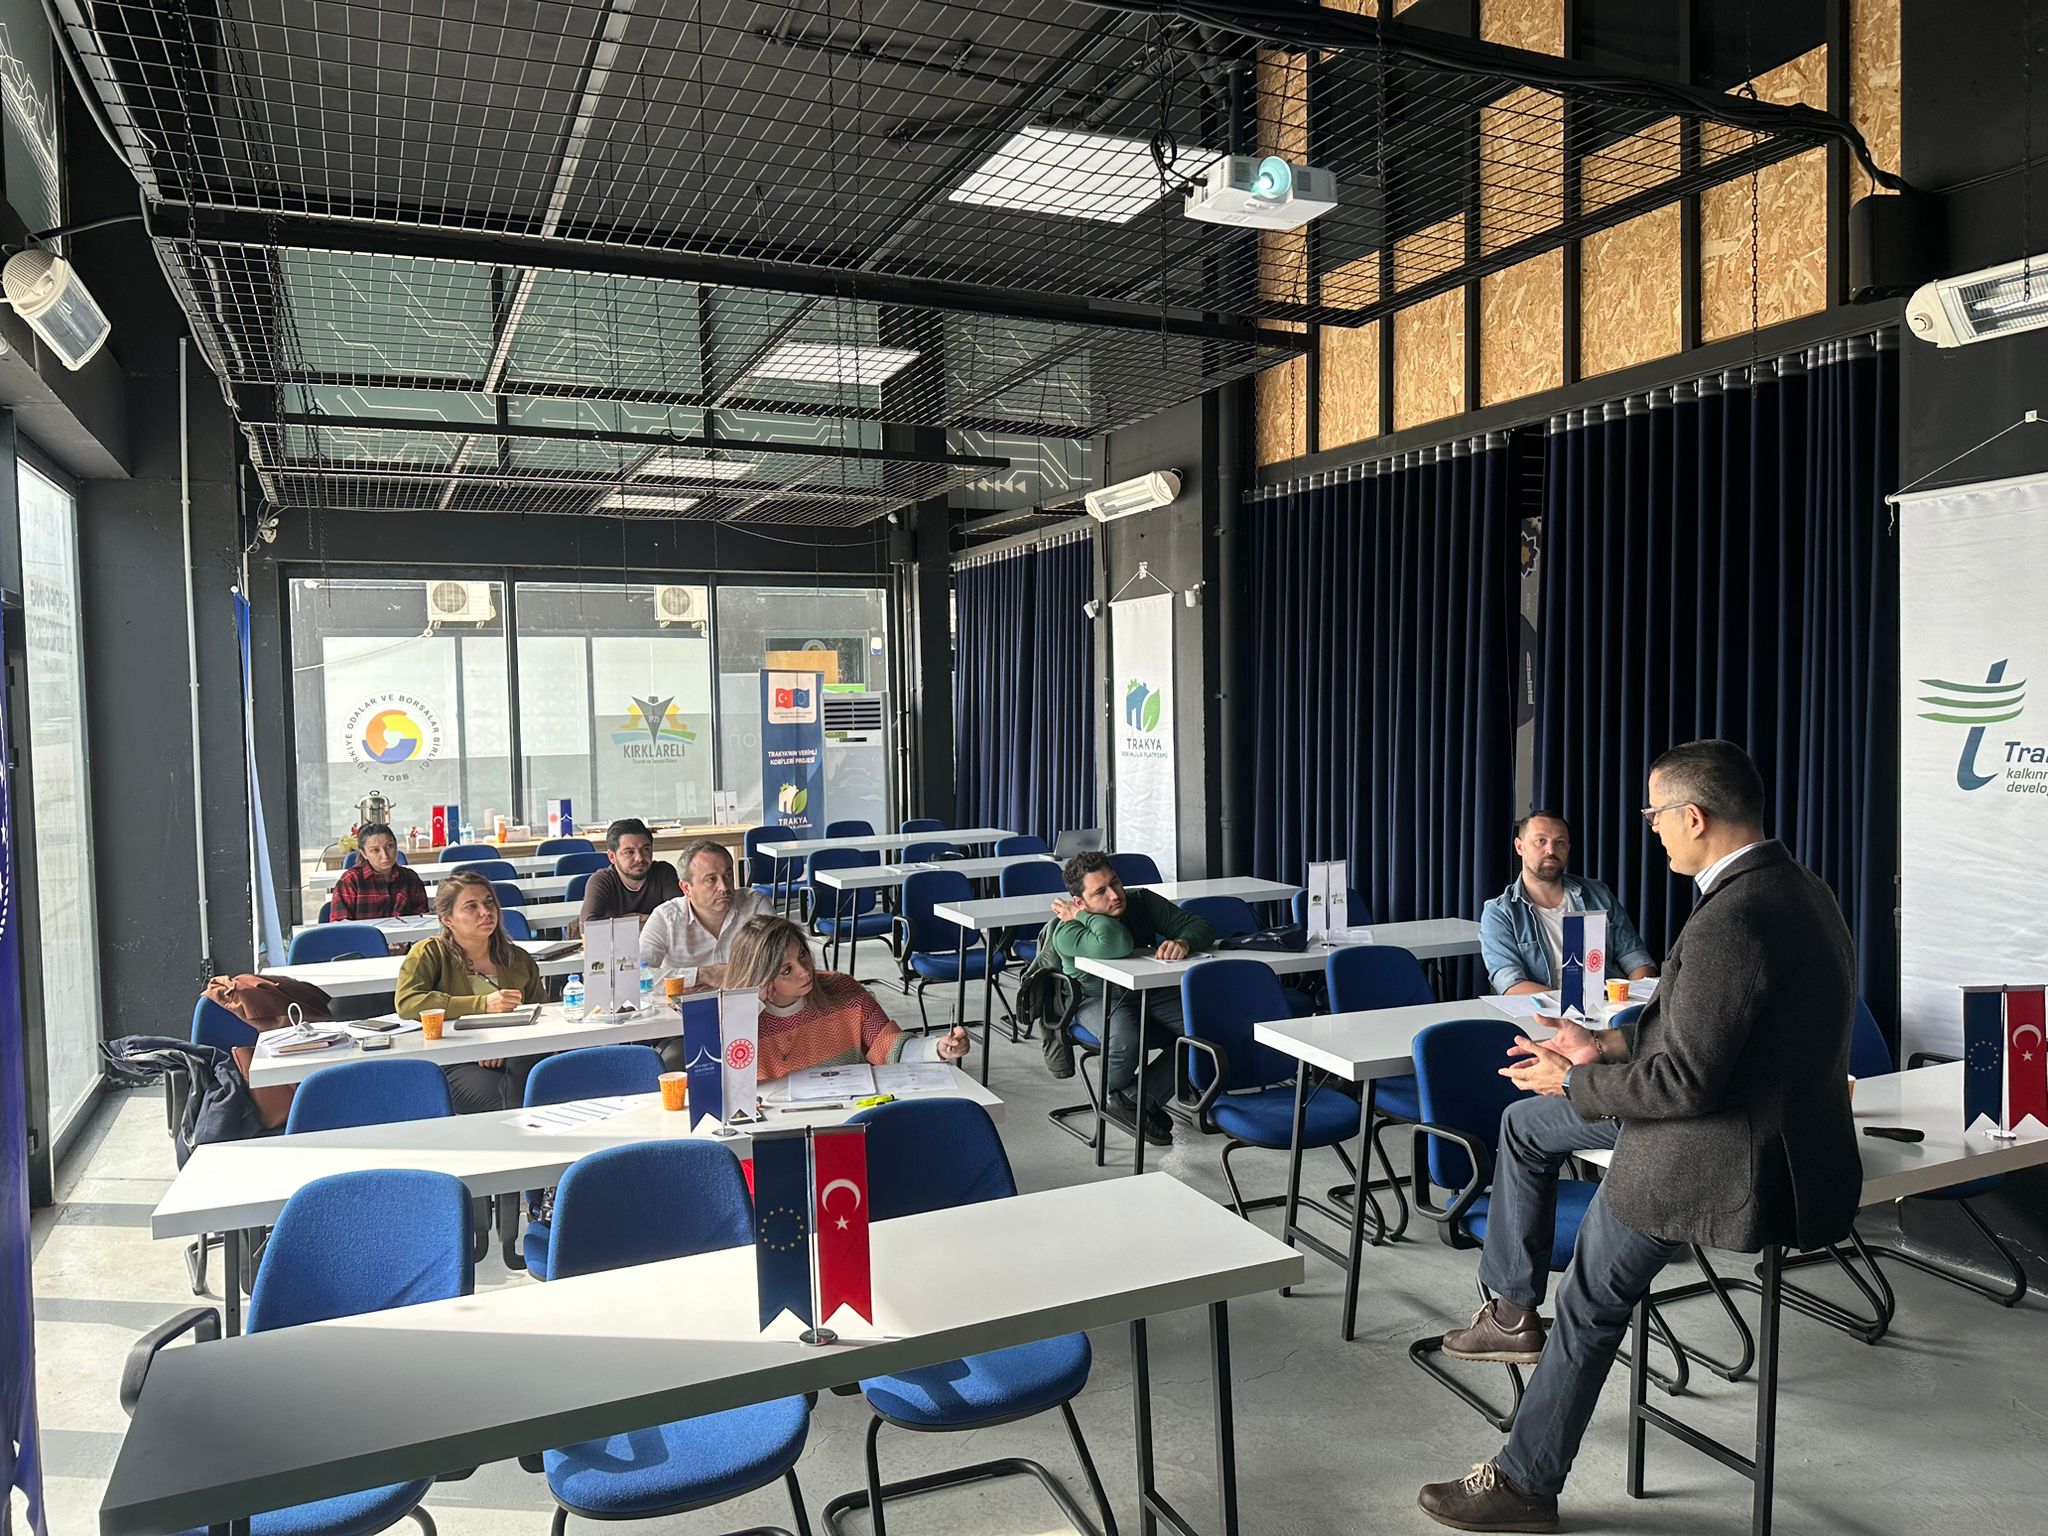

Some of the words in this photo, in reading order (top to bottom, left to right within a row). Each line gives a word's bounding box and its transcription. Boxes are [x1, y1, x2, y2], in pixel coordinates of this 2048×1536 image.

[346, 698, 378, 730] ODALAR
[380, 694, 394, 702] VE
[398, 694, 440, 734] BORSALAR
[1126, 738, 1162, 750] TRAKYA
[2004, 741, 2048, 763] Tra
[382, 773, 410, 782] TOBB
[2006, 781, 2048, 796] develo
[778, 816, 808, 826] TRAKYA
